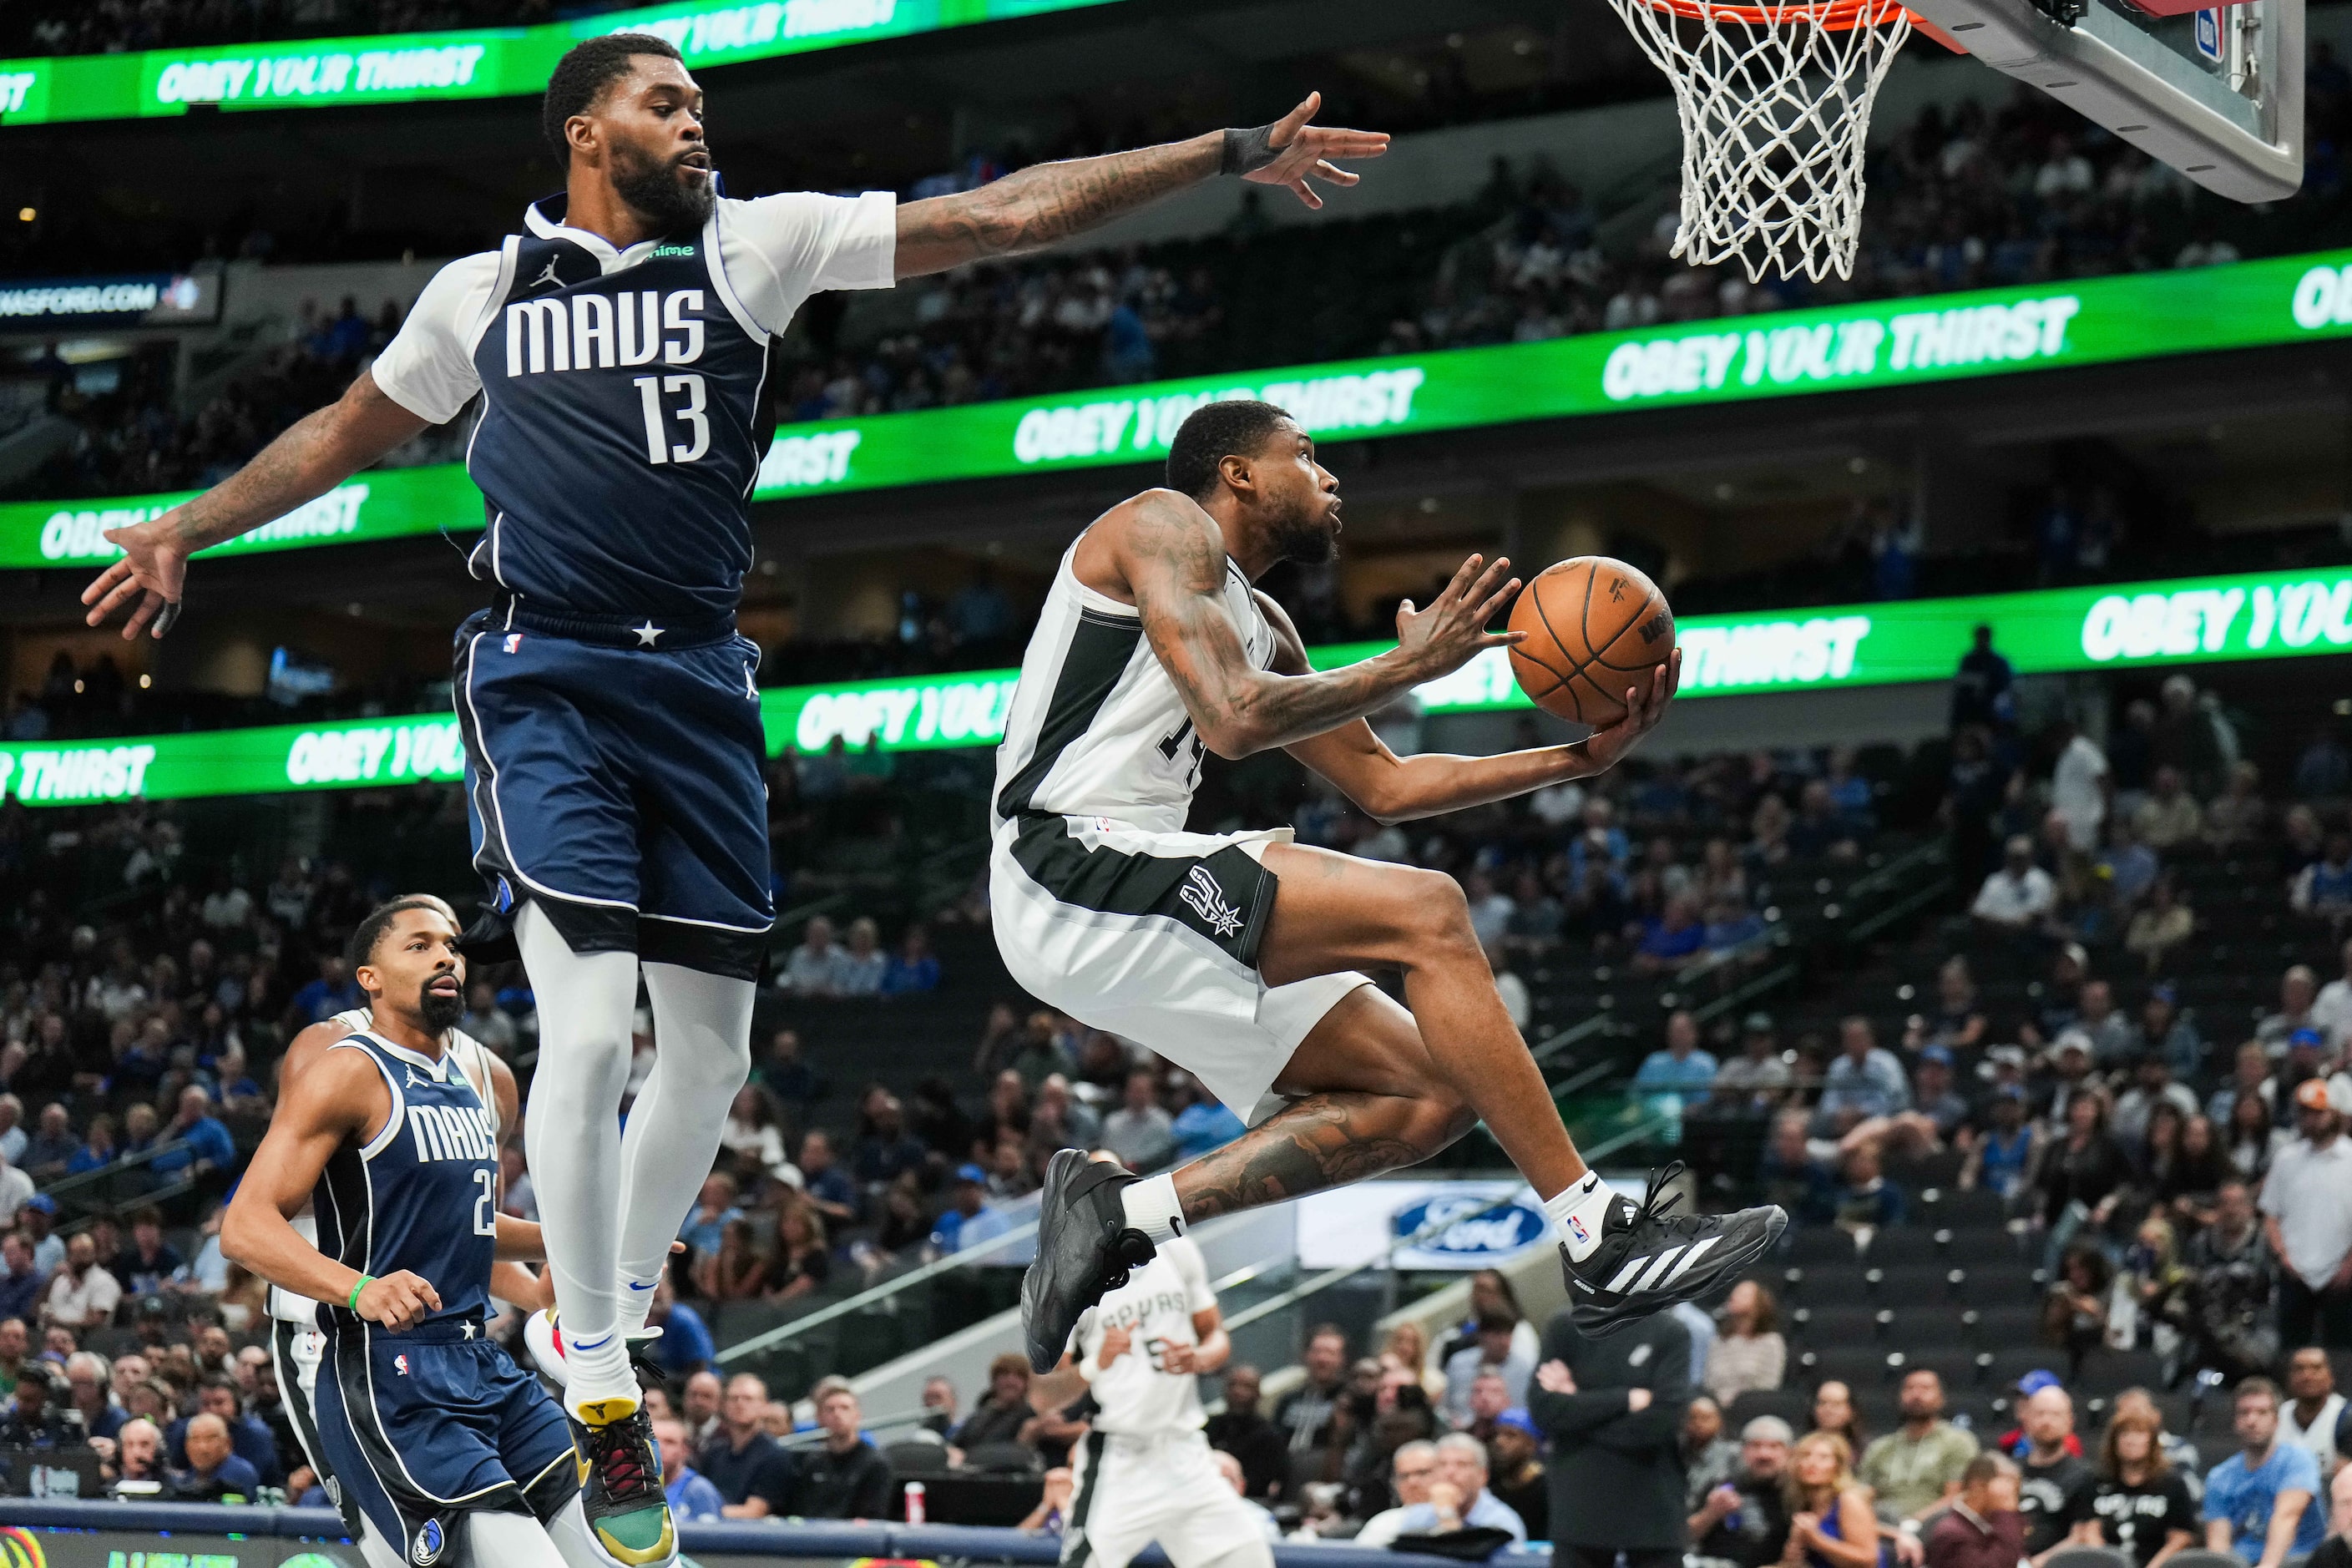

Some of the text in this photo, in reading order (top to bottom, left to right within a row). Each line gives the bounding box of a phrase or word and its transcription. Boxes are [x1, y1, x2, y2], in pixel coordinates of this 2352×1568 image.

[157, 45, 484, 103] OBEY YOUR THIRST
[506, 289, 705, 378] MAVS
[1603, 296, 2079, 399] OBEY YOUR THIRST
[633, 373, 711, 465] 13
[1014, 401, 1135, 463] OBEY
[1677, 615, 1871, 690] THIRST
[2081, 587, 2246, 661] OBEY
[18, 745, 156, 800] THIRST
[286, 727, 393, 785] OBEY
[473, 1169, 498, 1240] 2
